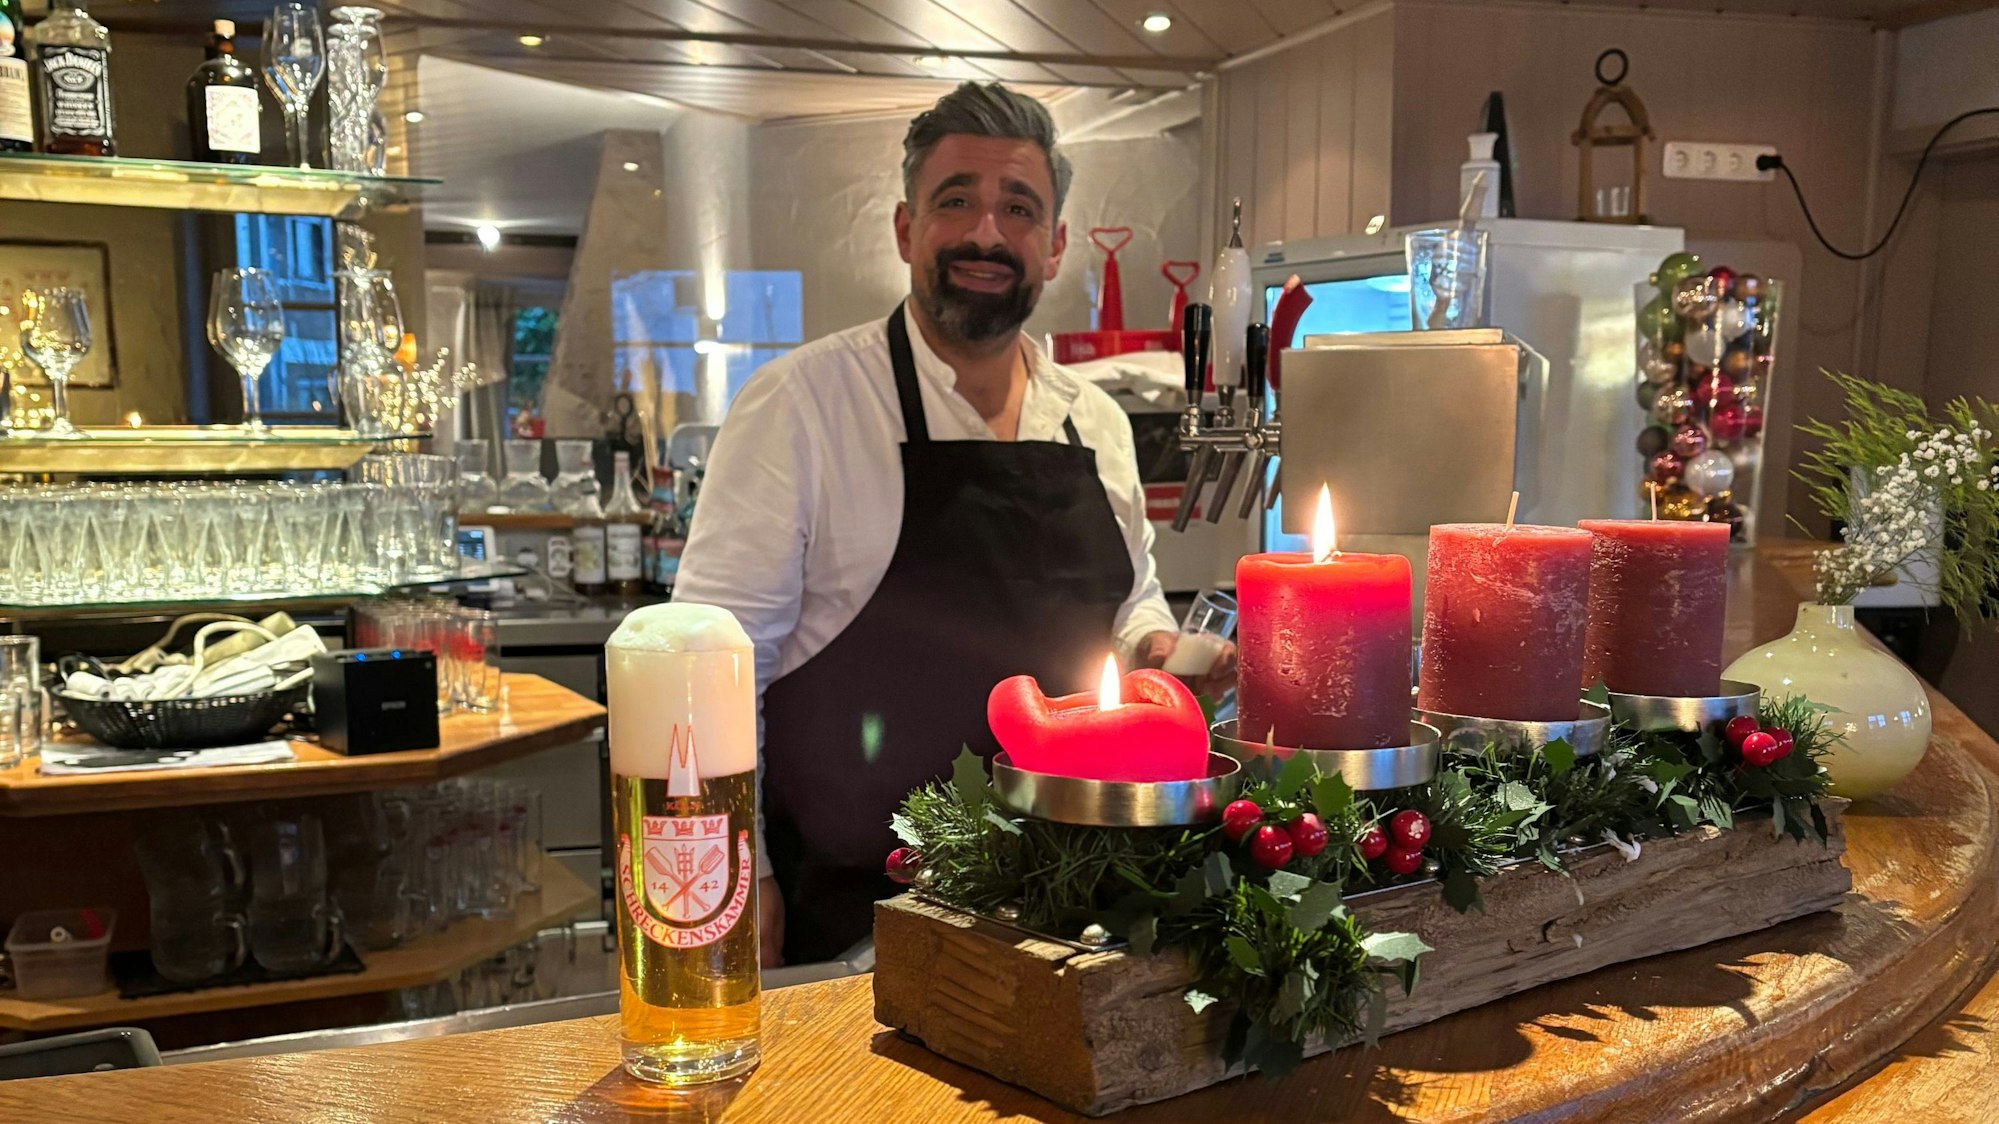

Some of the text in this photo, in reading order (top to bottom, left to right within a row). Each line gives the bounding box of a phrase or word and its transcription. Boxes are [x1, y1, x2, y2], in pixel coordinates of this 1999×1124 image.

[621, 858, 751, 946] SCHRECKENSKAMMER
[651, 880, 719, 894] 14 42
